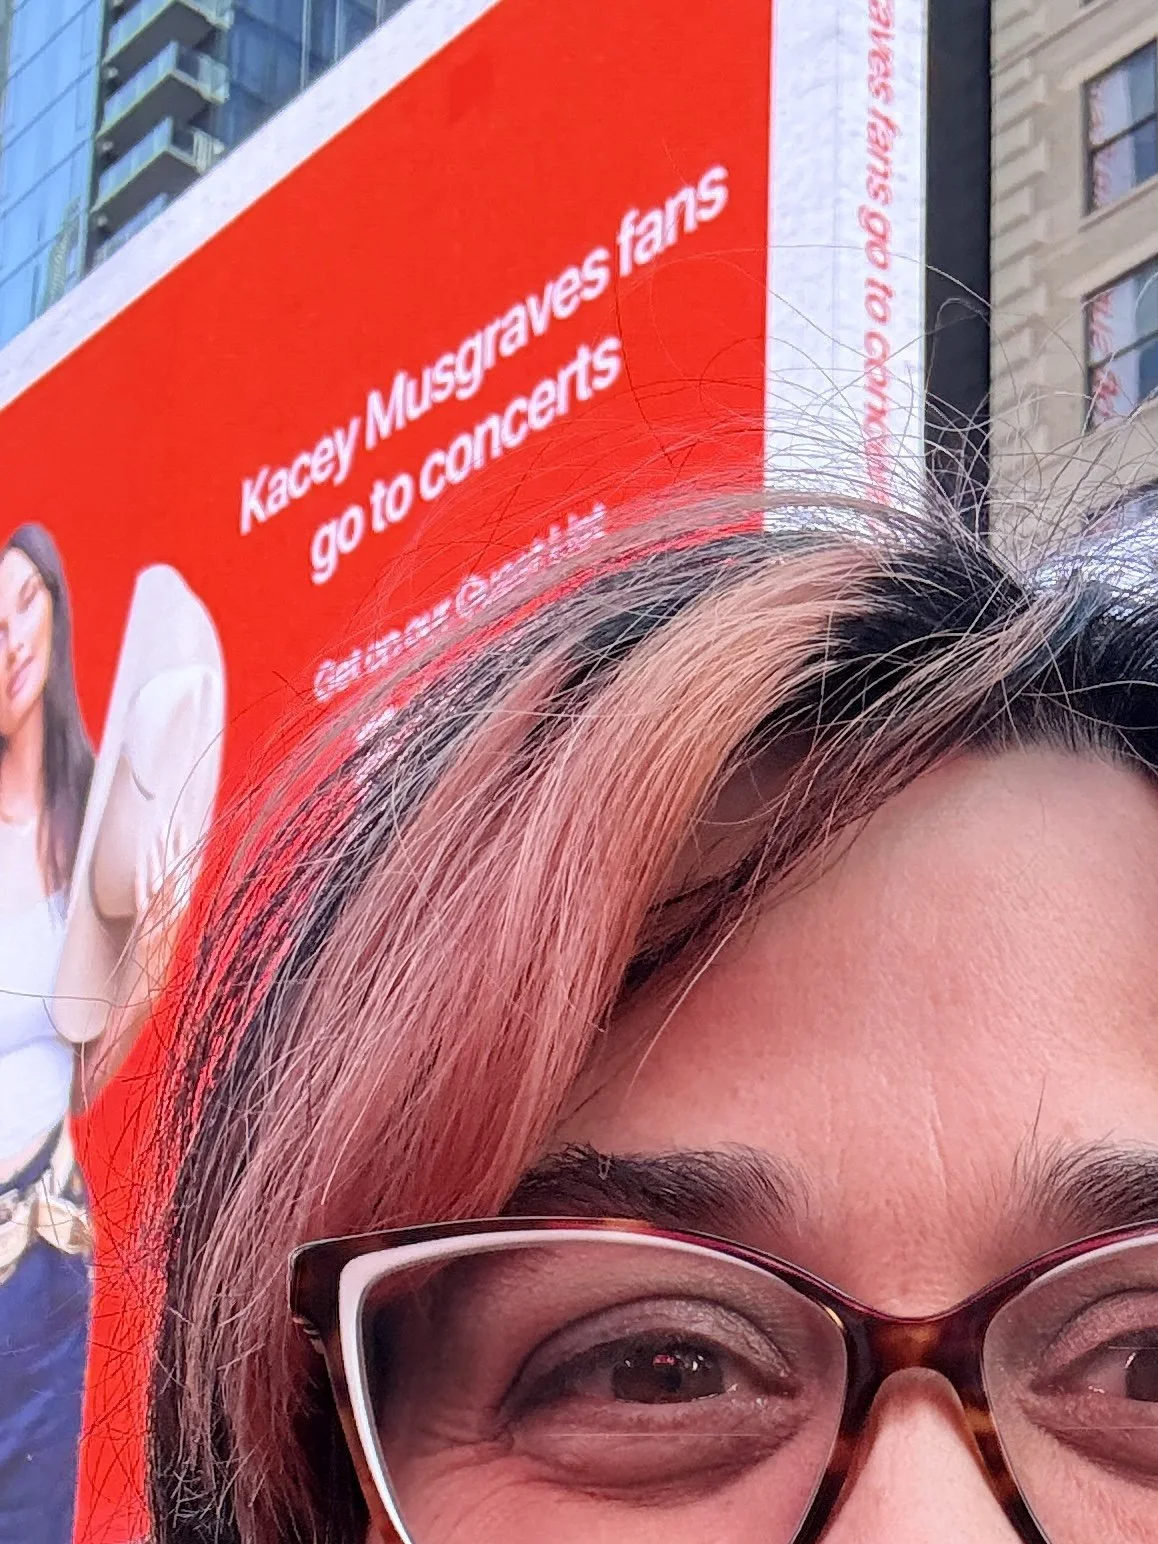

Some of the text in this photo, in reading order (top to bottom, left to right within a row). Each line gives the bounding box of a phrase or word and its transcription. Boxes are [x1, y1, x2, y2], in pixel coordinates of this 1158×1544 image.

[866, 105, 903, 205] fans
[857, 203, 893, 271] go
[239, 164, 730, 536] Kacey Musgraves fans
[864, 277, 897, 326] to
[310, 335, 622, 585] go to concerts
